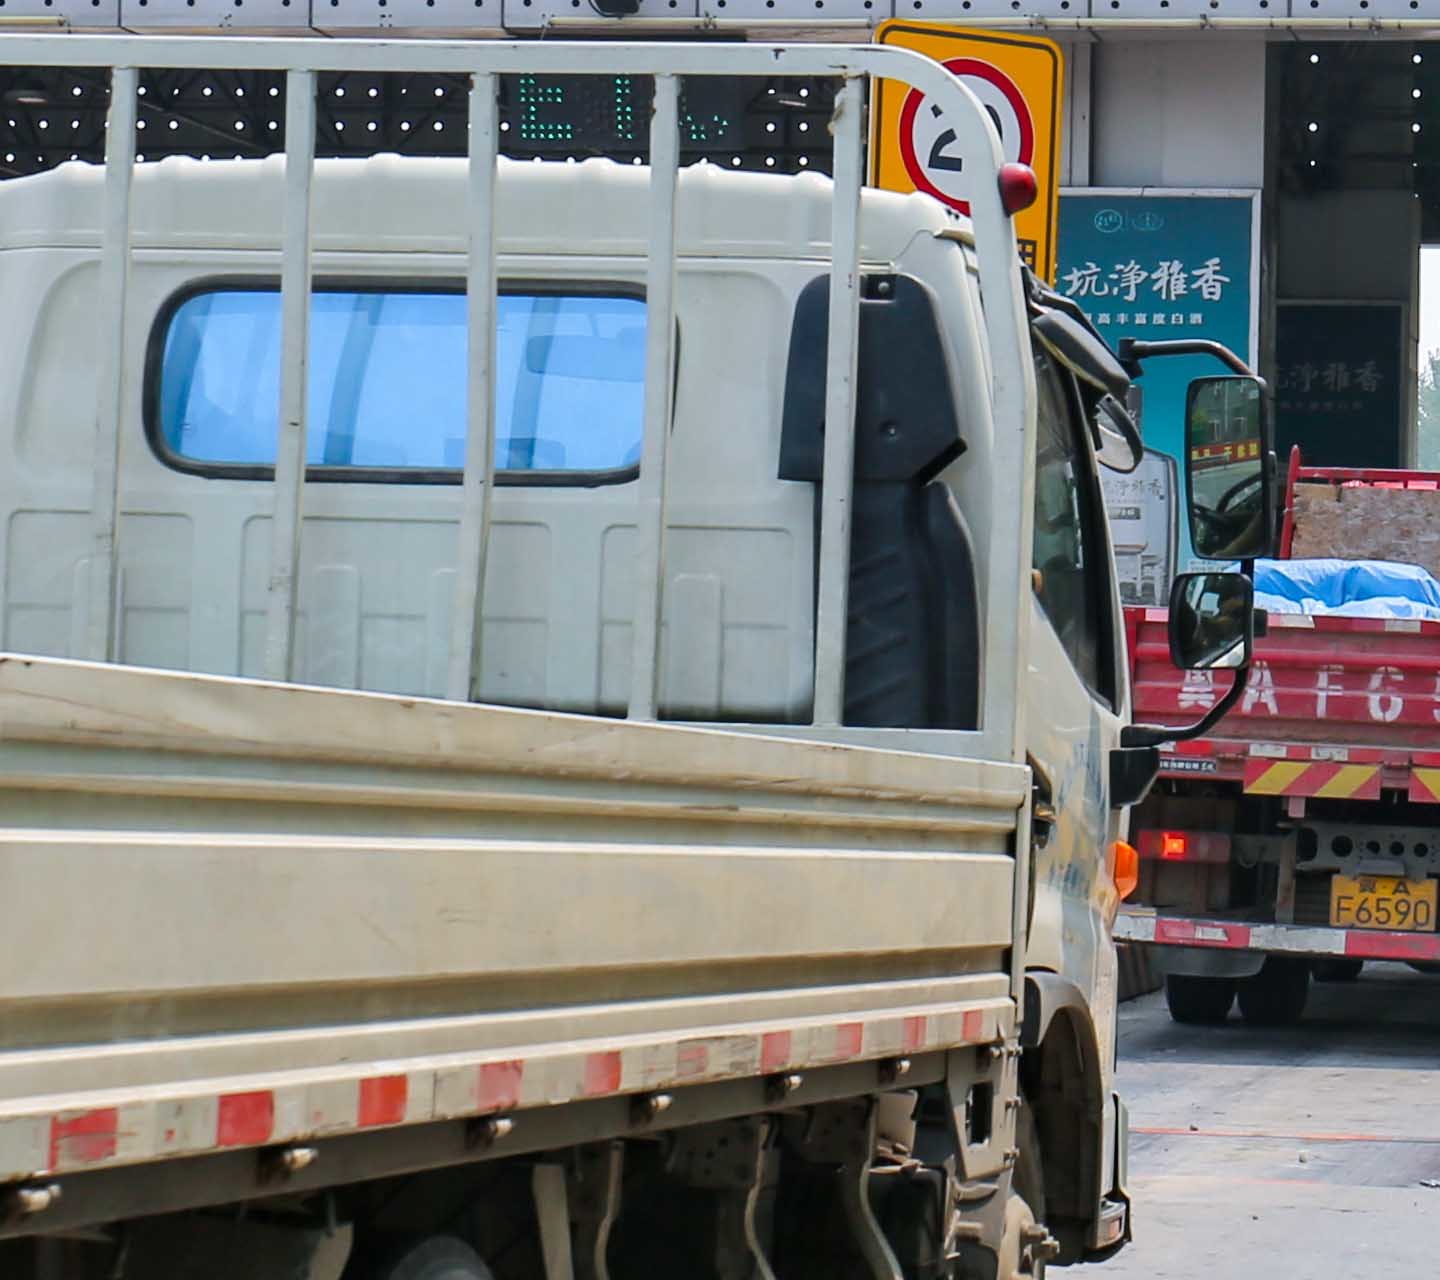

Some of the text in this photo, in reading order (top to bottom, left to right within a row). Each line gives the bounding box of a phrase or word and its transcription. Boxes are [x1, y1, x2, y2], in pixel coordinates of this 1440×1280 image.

[1054, 255, 1231, 303] 坑净雅香
[1335, 896, 1430, 927] F6590
